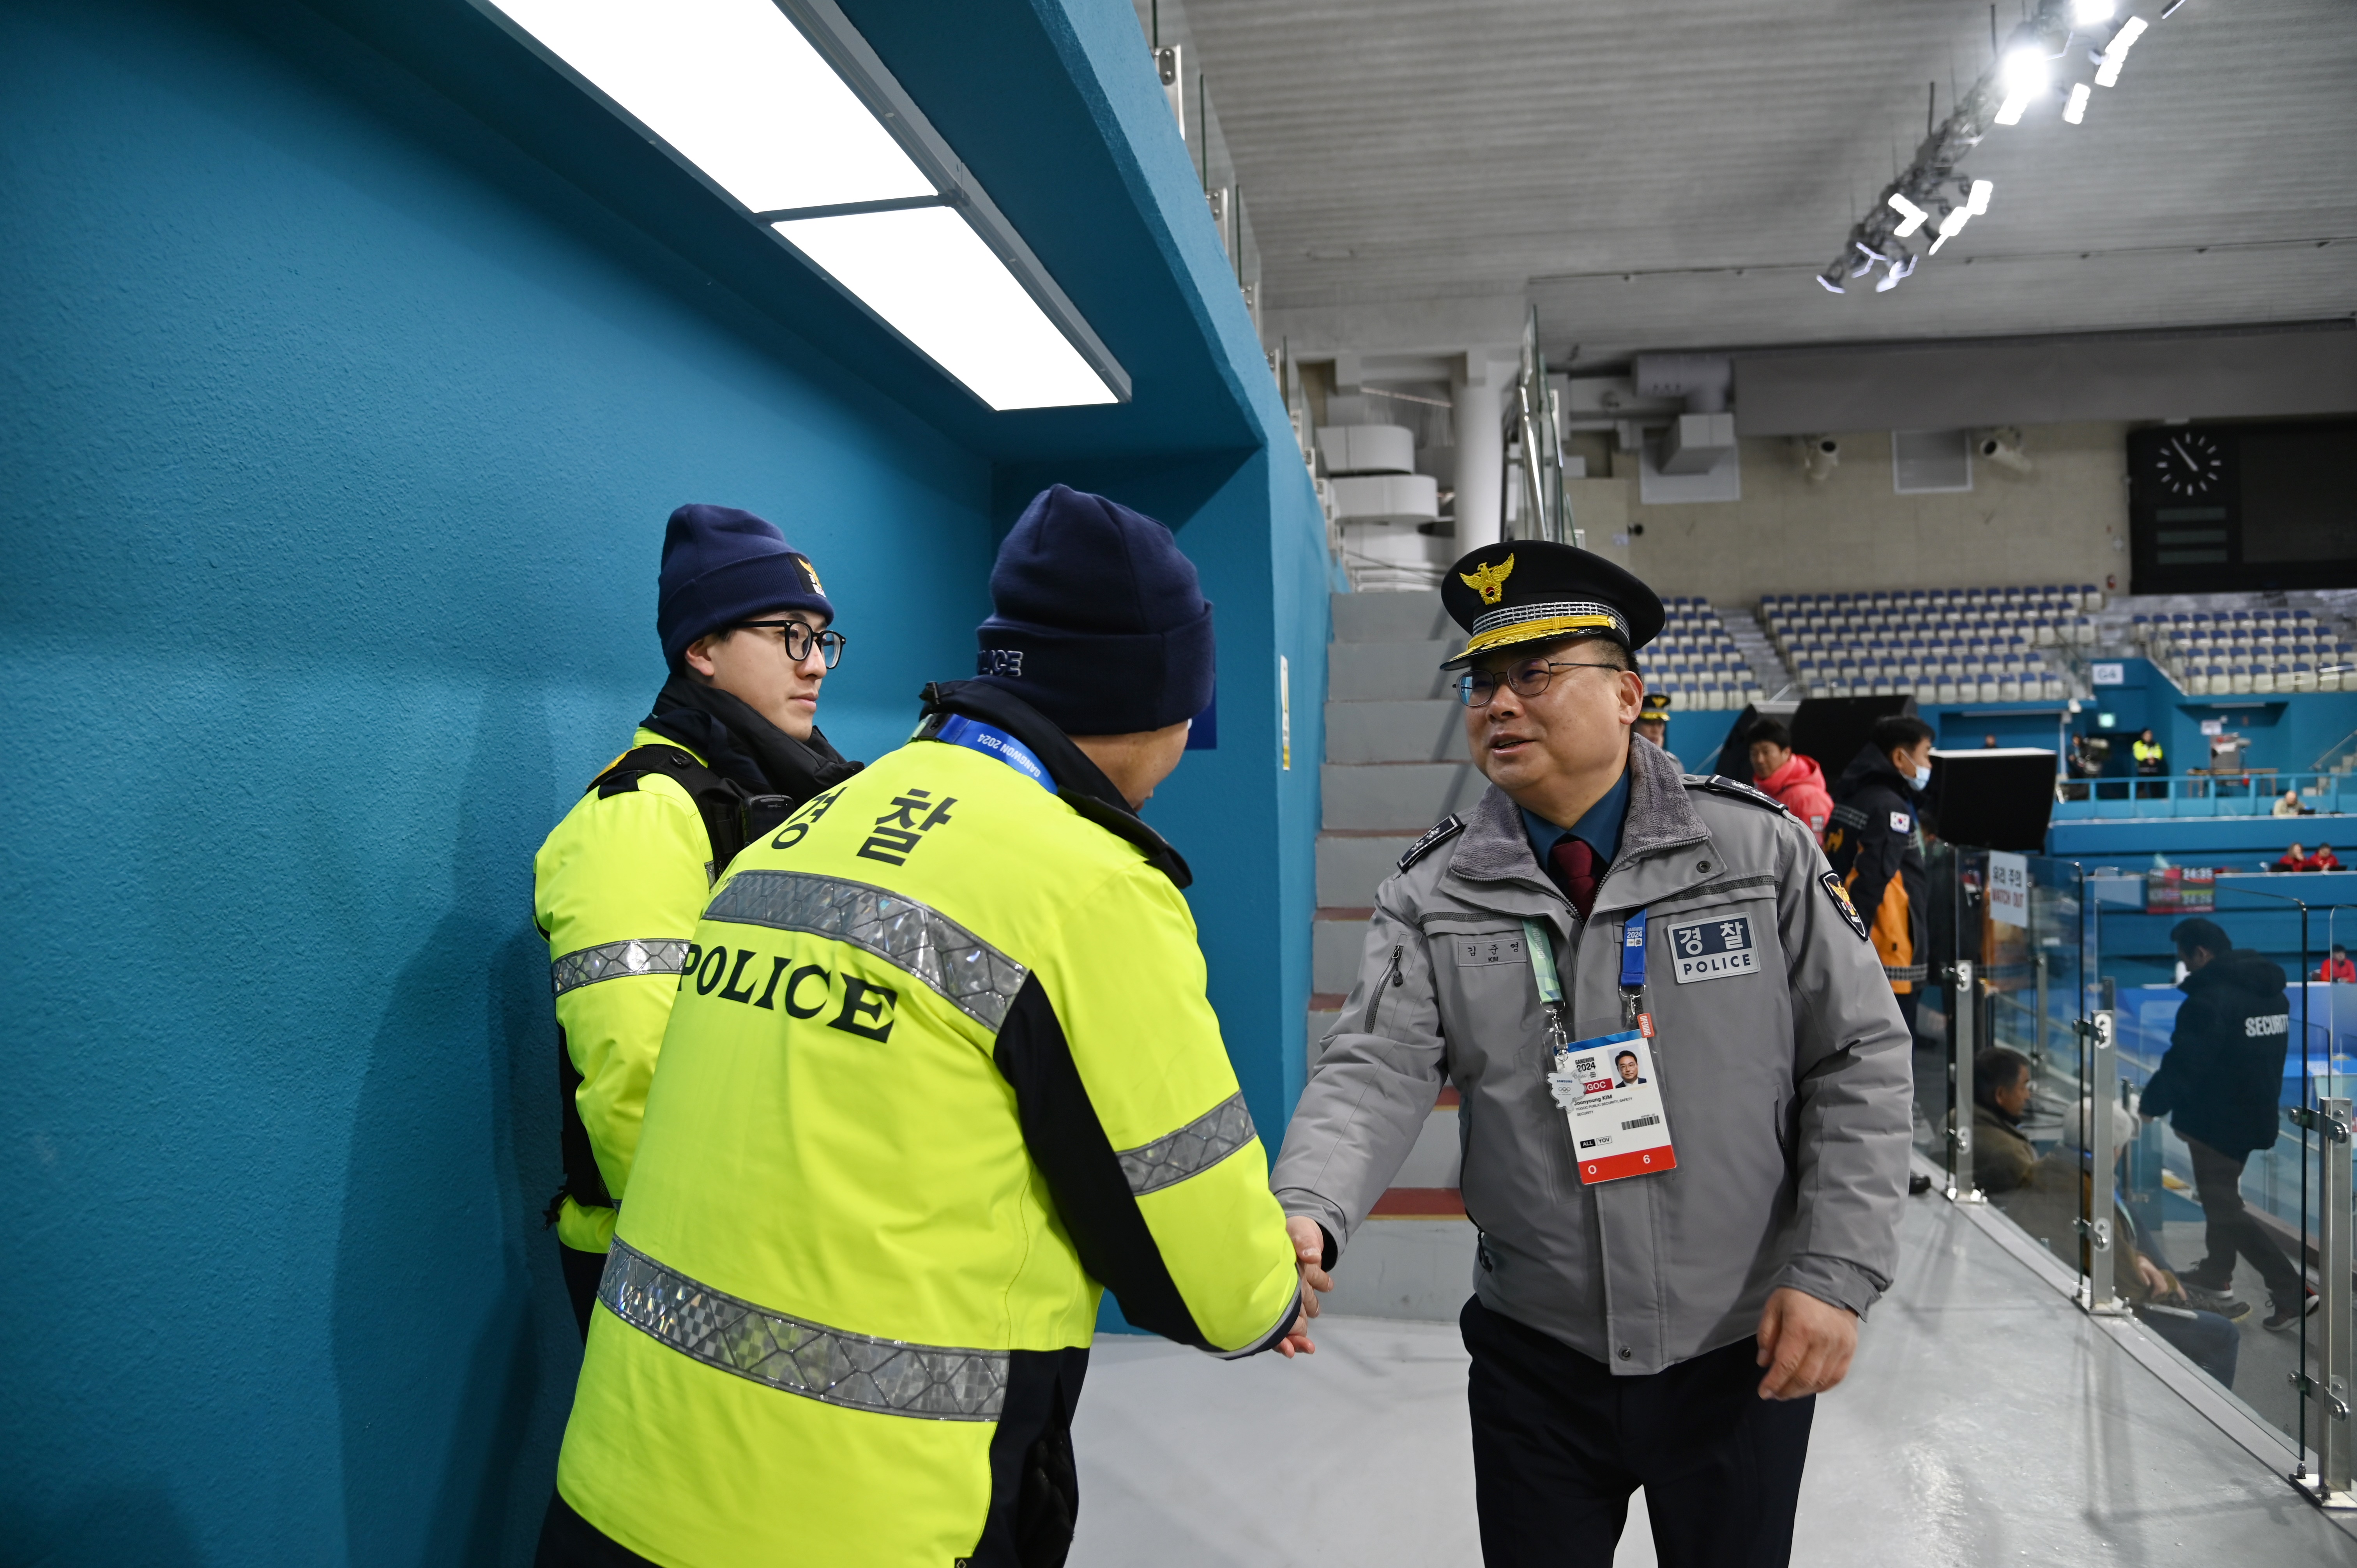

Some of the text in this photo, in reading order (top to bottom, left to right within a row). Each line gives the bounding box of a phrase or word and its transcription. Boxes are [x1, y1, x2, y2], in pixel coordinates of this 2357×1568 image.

[977, 733, 1041, 778] GANGWON 2024
[1992, 888, 2024, 909] WATCH OUT
[1532, 928, 1546, 959] GANGWON
[1684, 954, 1751, 975] POLICE
[677, 944, 898, 1044] POLICE
[1640, 1015, 1651, 1036] OPENING
[1577, 1062, 1596, 1072] 2024
[1574, 1097, 1601, 1106] Joonyoung
[1643, 1154, 1650, 1164] 6
